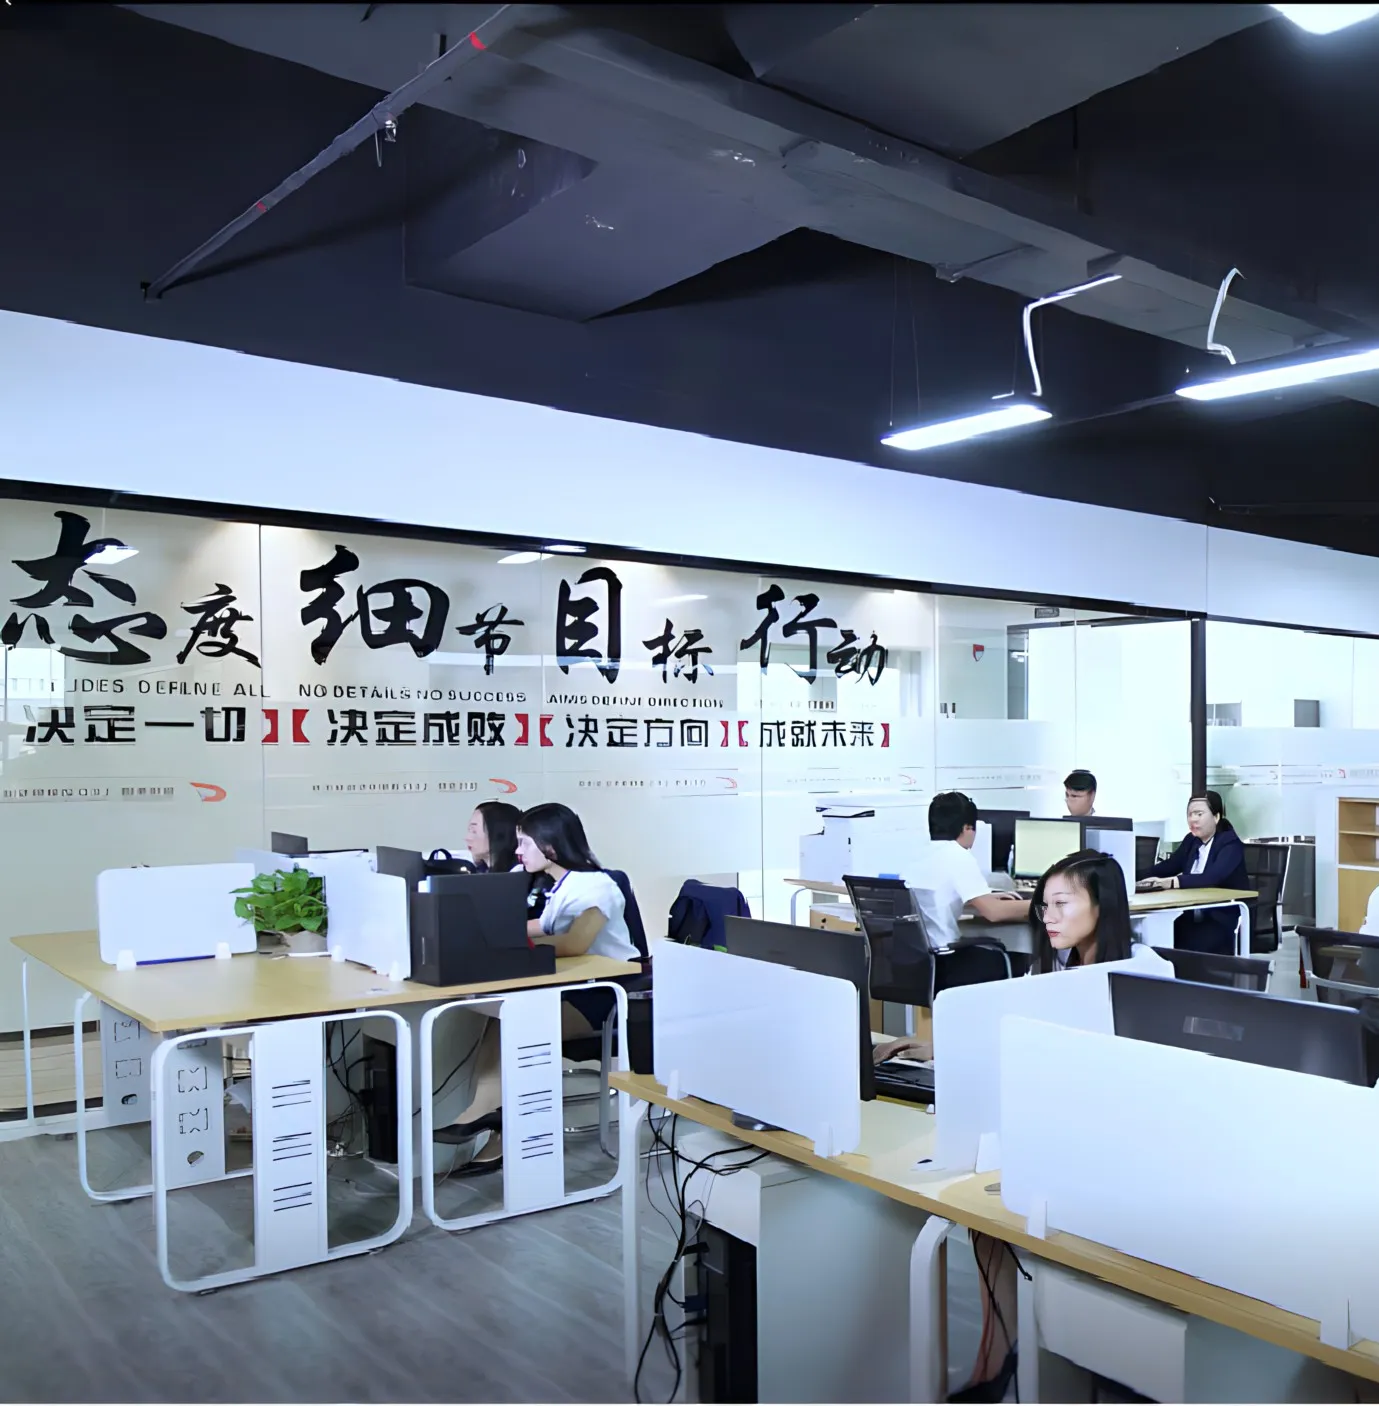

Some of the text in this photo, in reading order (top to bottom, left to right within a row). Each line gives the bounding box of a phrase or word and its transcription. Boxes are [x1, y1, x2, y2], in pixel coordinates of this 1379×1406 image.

[0, 511, 888, 686] 态度 细节 目标 行动
[299, 684, 327, 698] NO
